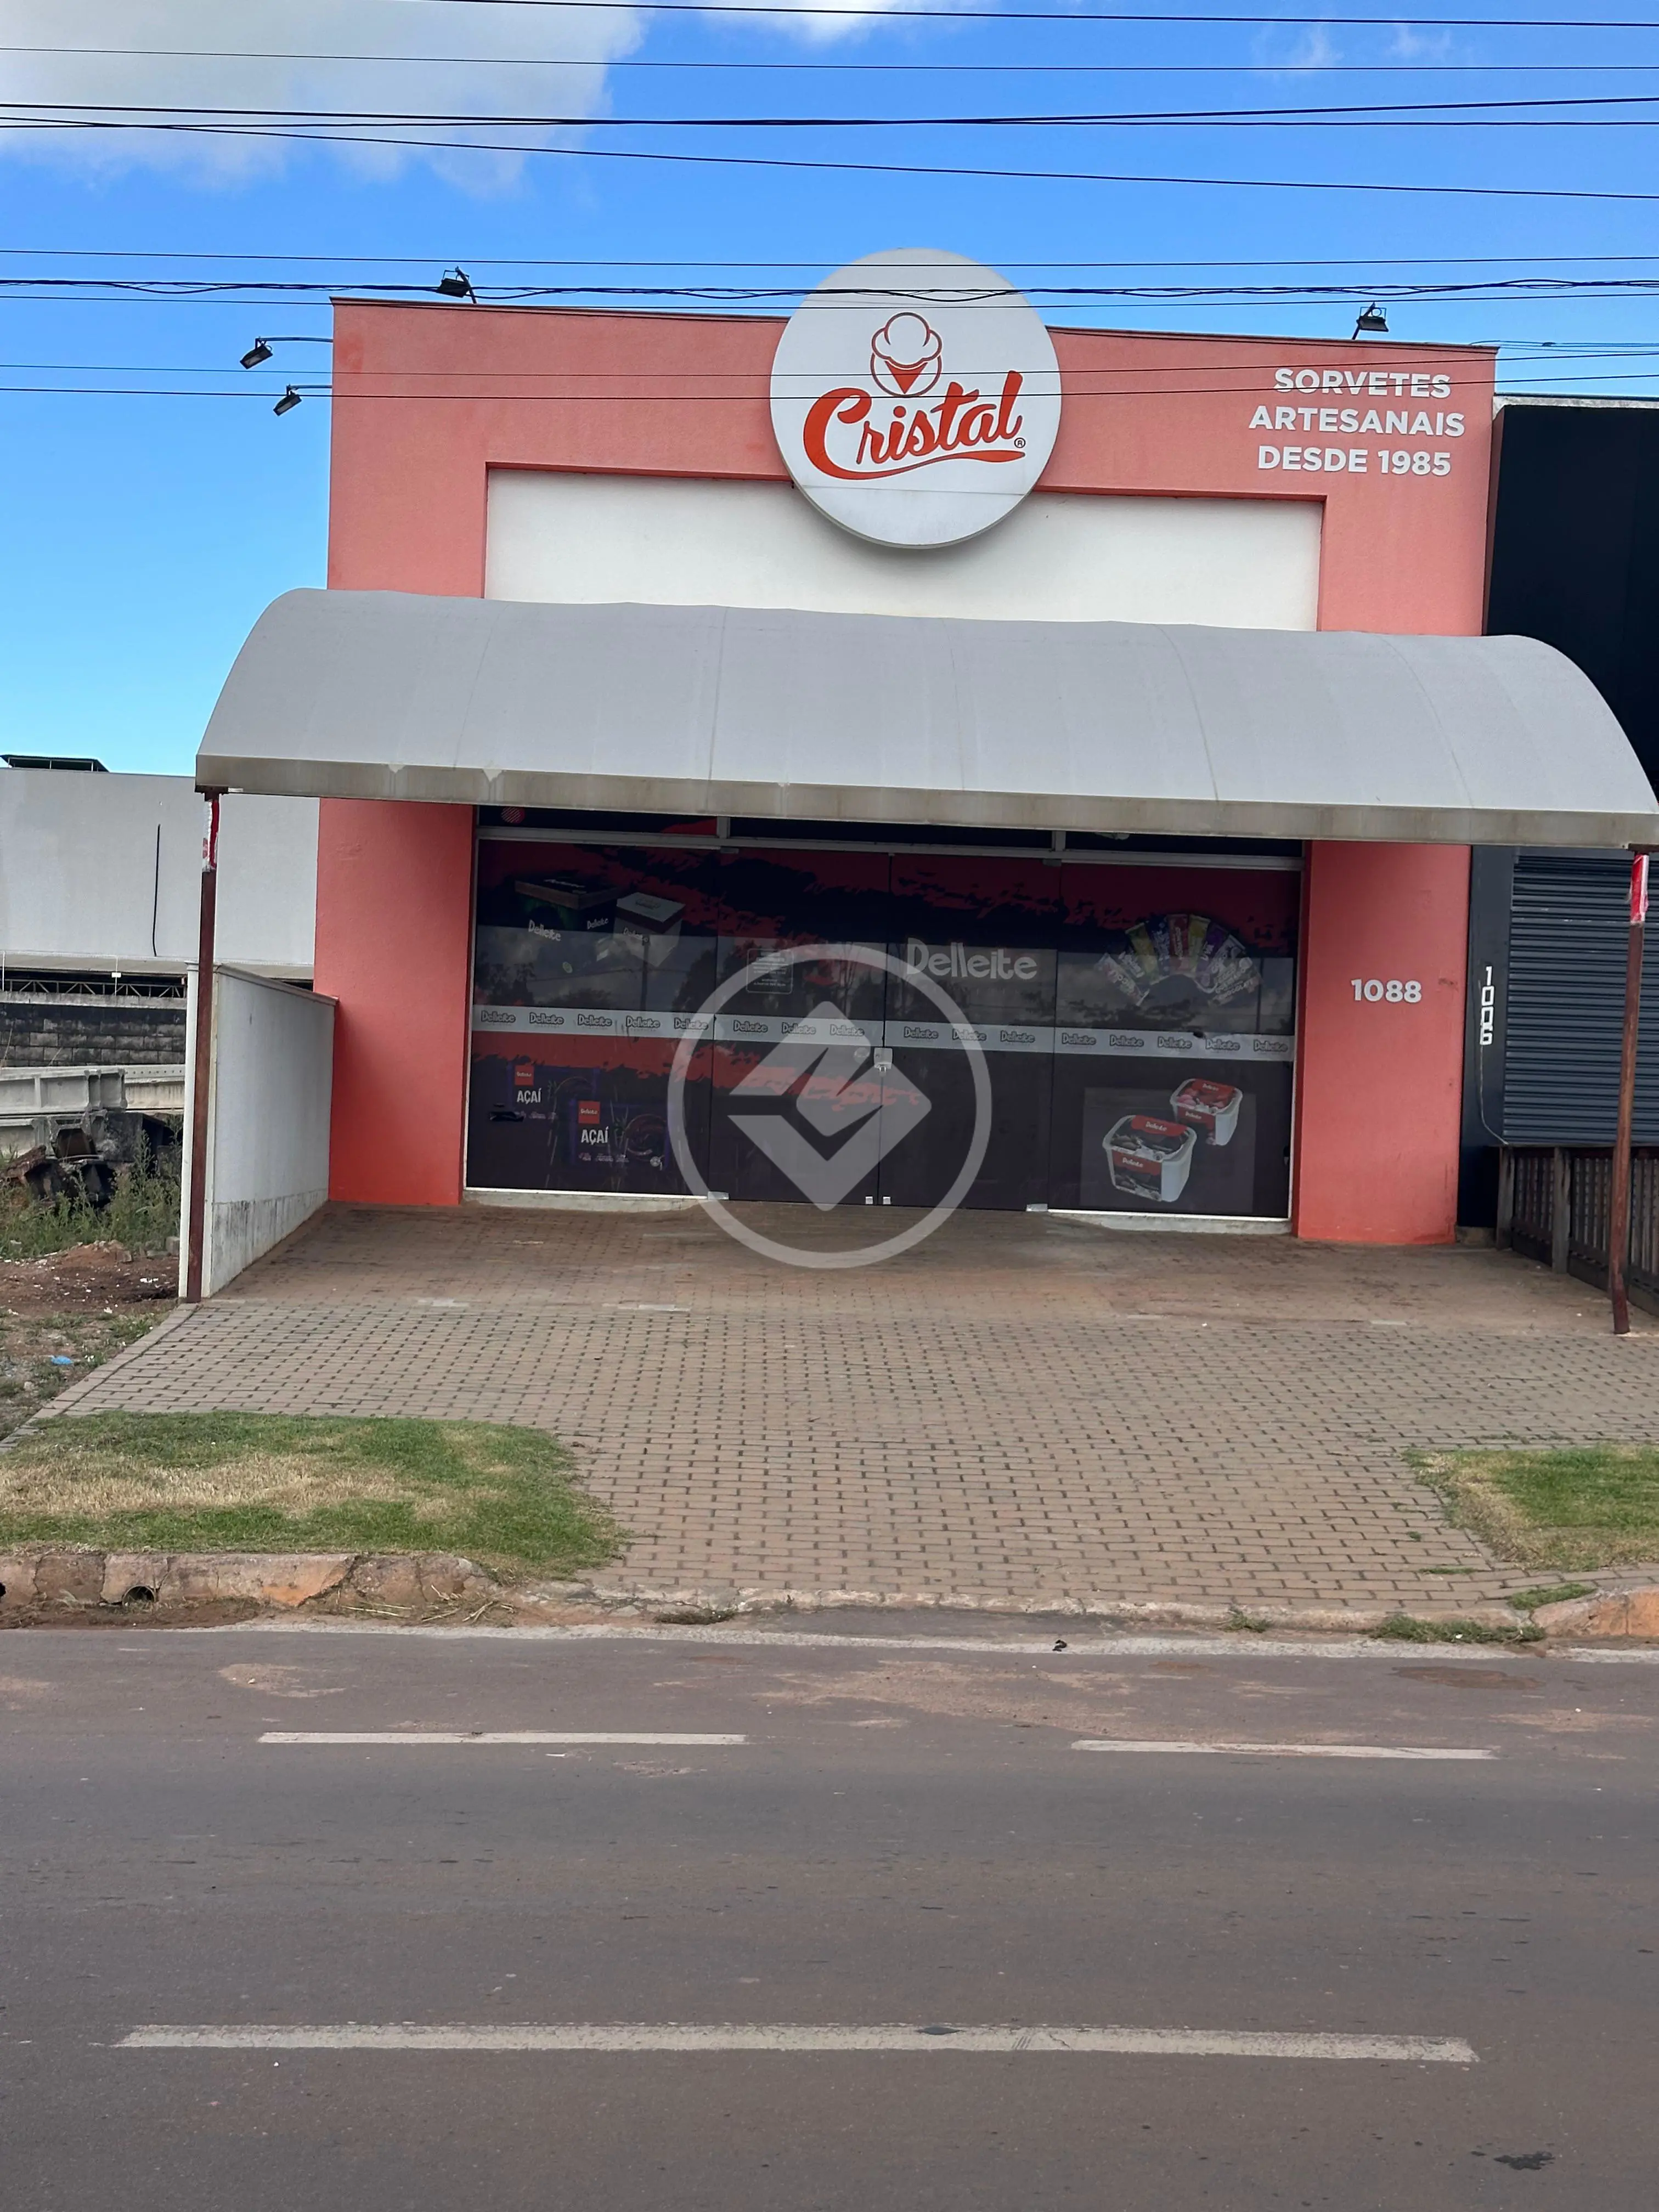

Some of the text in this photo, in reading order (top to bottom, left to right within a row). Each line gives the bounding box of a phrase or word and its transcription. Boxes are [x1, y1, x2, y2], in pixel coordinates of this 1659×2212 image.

[1273, 368, 1451, 399] SORVETES
[803, 370, 1025, 480] Cristal
[1249, 405, 1465, 437] ARTESANAIS
[1258, 445, 1451, 476] DESDE 1985
[907, 937, 1038, 980] Delleite
[1351, 978, 1422, 1003] 1088
[1480, 966, 1494, 1046] 1006
[517, 1087, 542, 1104] AÇAÍ
[580, 1126, 609, 1145] AÇAÍ
